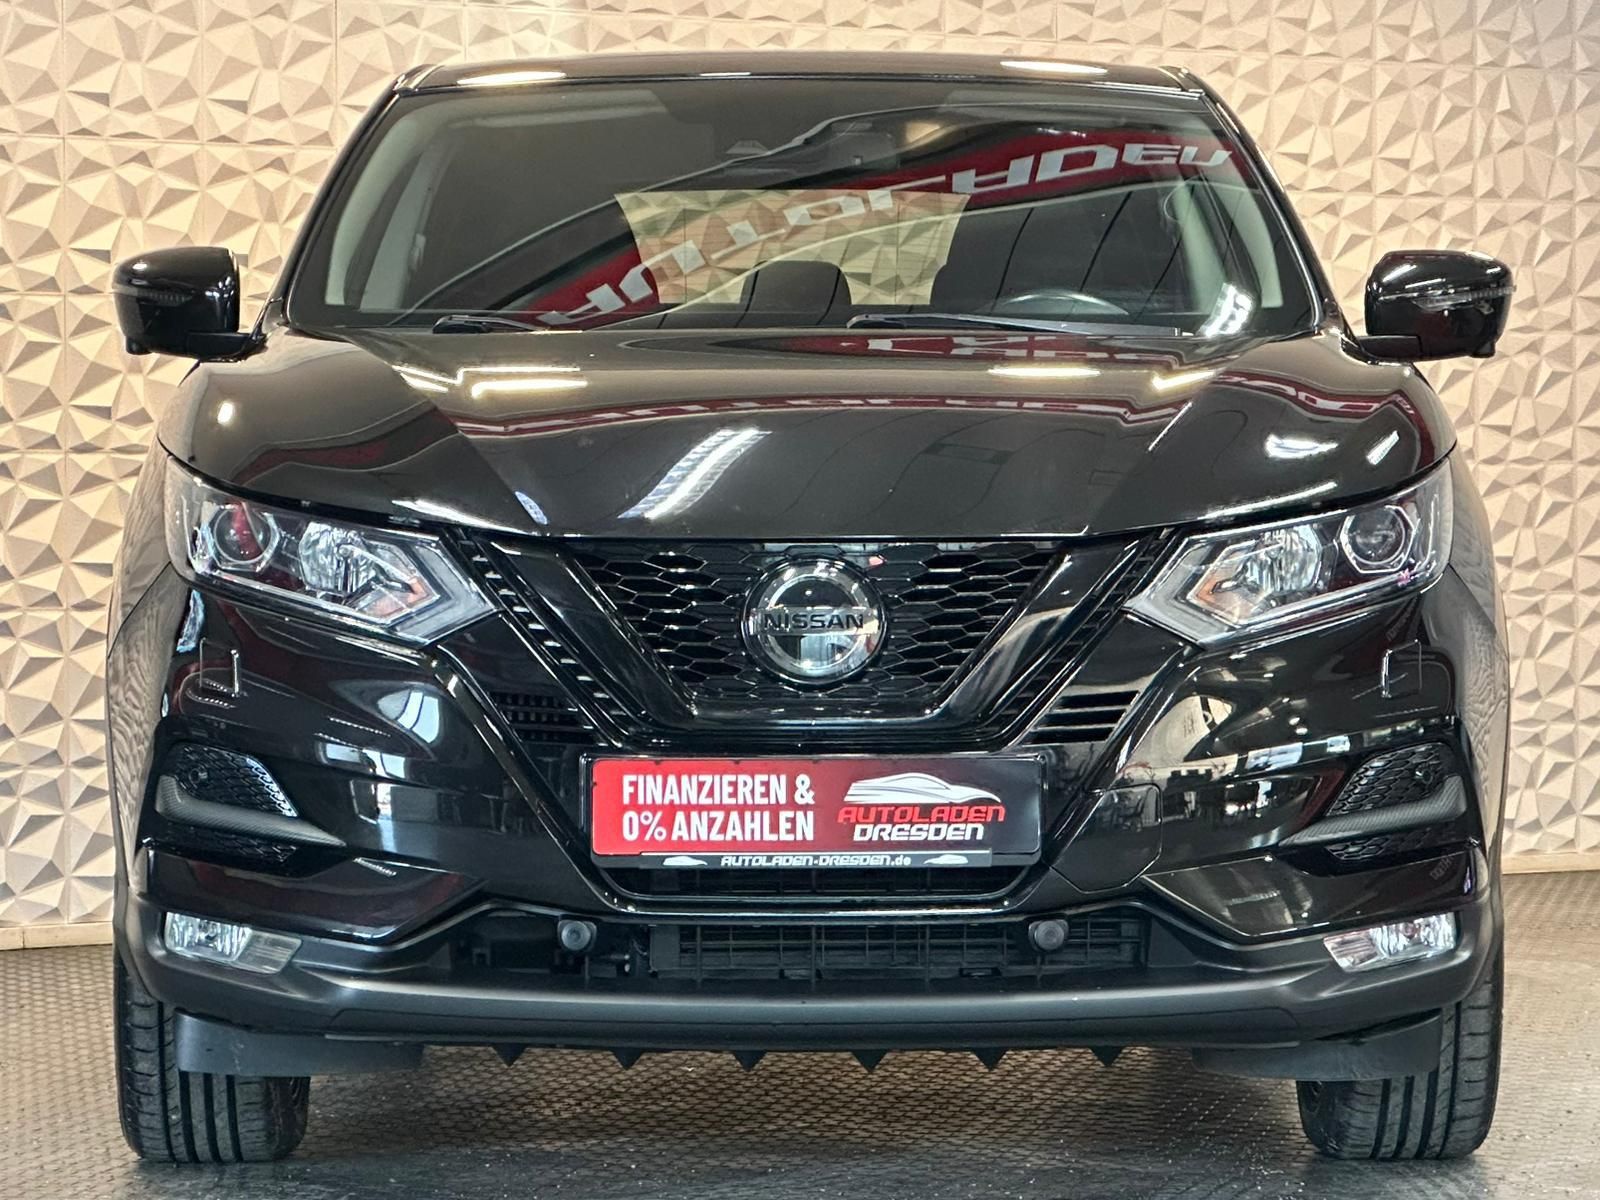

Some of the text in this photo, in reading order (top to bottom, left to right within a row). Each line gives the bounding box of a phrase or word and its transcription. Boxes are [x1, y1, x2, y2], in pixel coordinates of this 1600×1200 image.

[764, 613, 864, 630] NISSAN
[622, 773, 815, 805] FINANZIEREN &
[837, 805, 1006, 823] AUTOLADEN
[622, 810, 815, 841] 0% ANZAHLEN
[853, 823, 985, 841] DRESDEN
